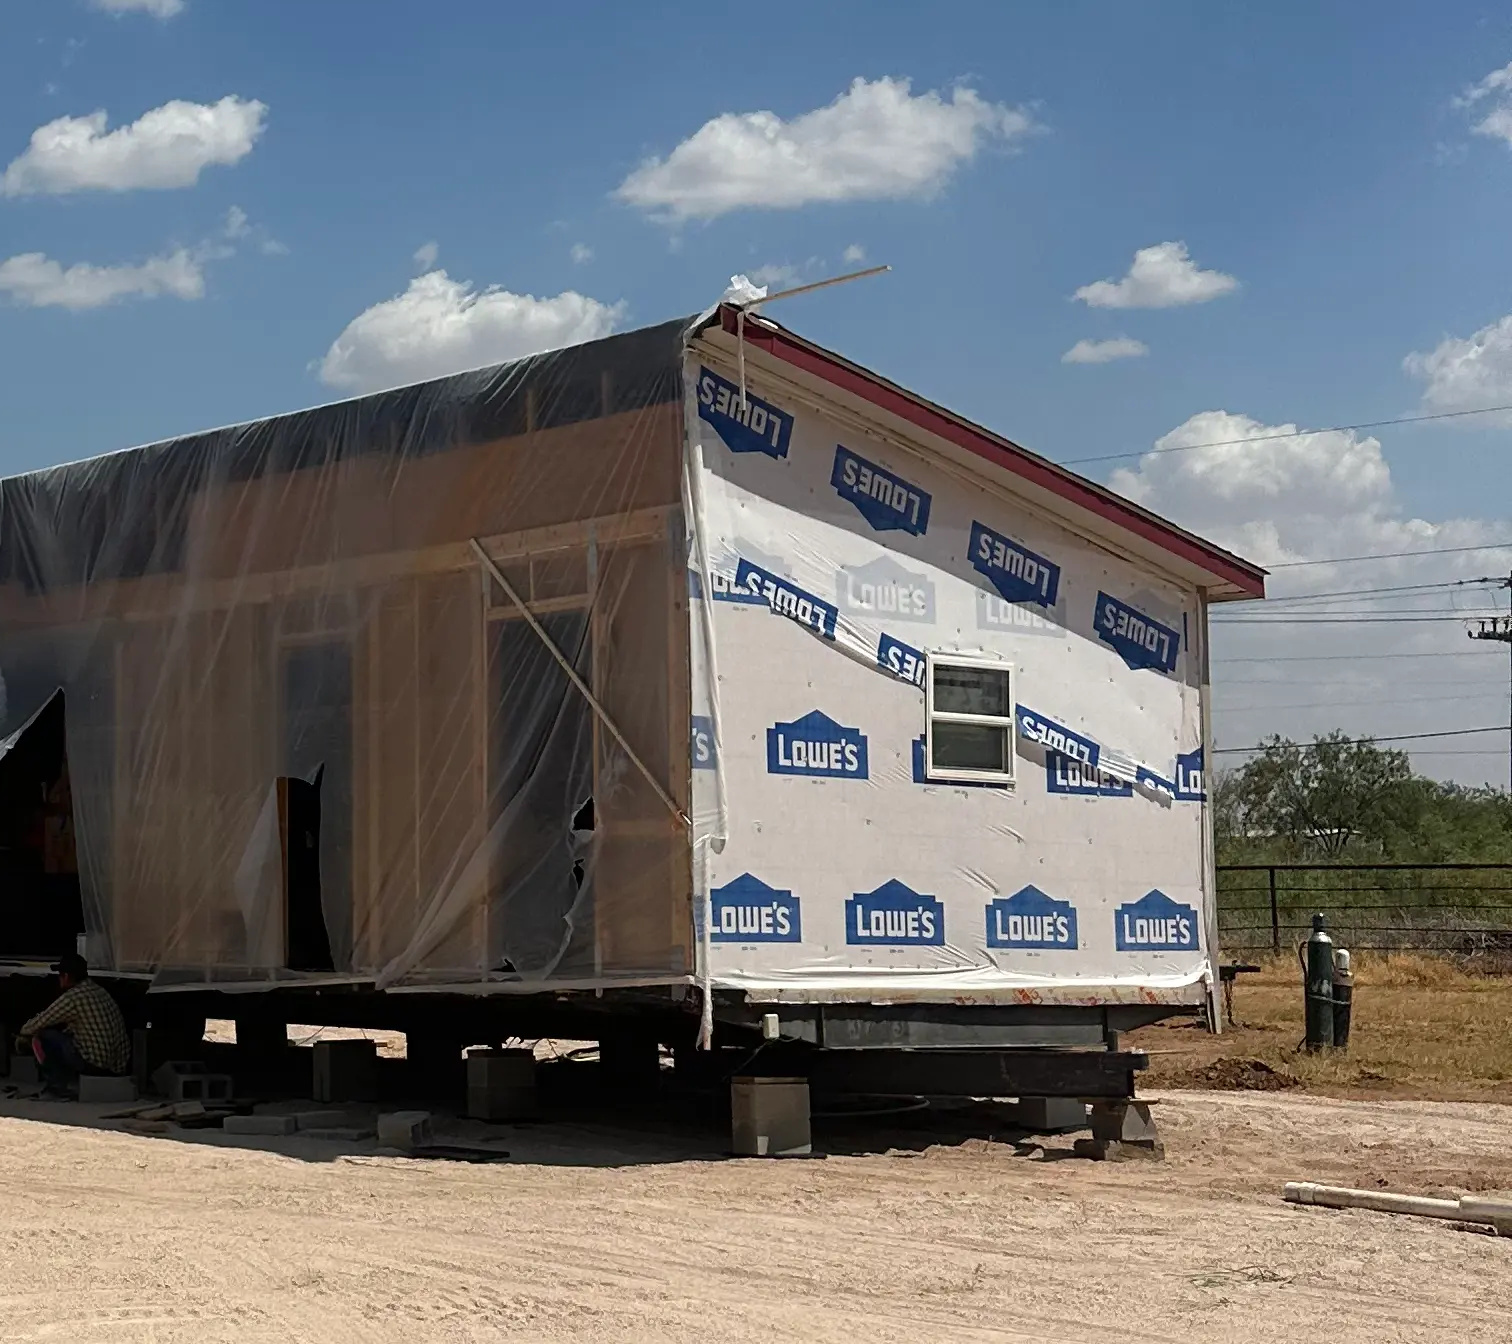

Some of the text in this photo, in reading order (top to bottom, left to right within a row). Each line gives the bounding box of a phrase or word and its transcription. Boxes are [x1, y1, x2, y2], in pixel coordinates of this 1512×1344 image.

[699, 375, 782, 448] LOWE'S
[842, 458, 921, 526] LOWE'S
[978, 533, 1050, 598] LOWE'S
[745, 571, 827, 636] LOWES
[847, 574, 927, 617] LOWE'S
[1103, 603, 1170, 664] LOWE'S
[777, 733, 859, 772] LOWE'S
[1055, 756, 1124, 790] LOWES
[710, 900, 791, 936] LOWE'S
[856, 904, 936, 939] LOWE'S
[995, 909, 1069, 943] LOWE'S
[1123, 913, 1191, 945] LOWE'S
